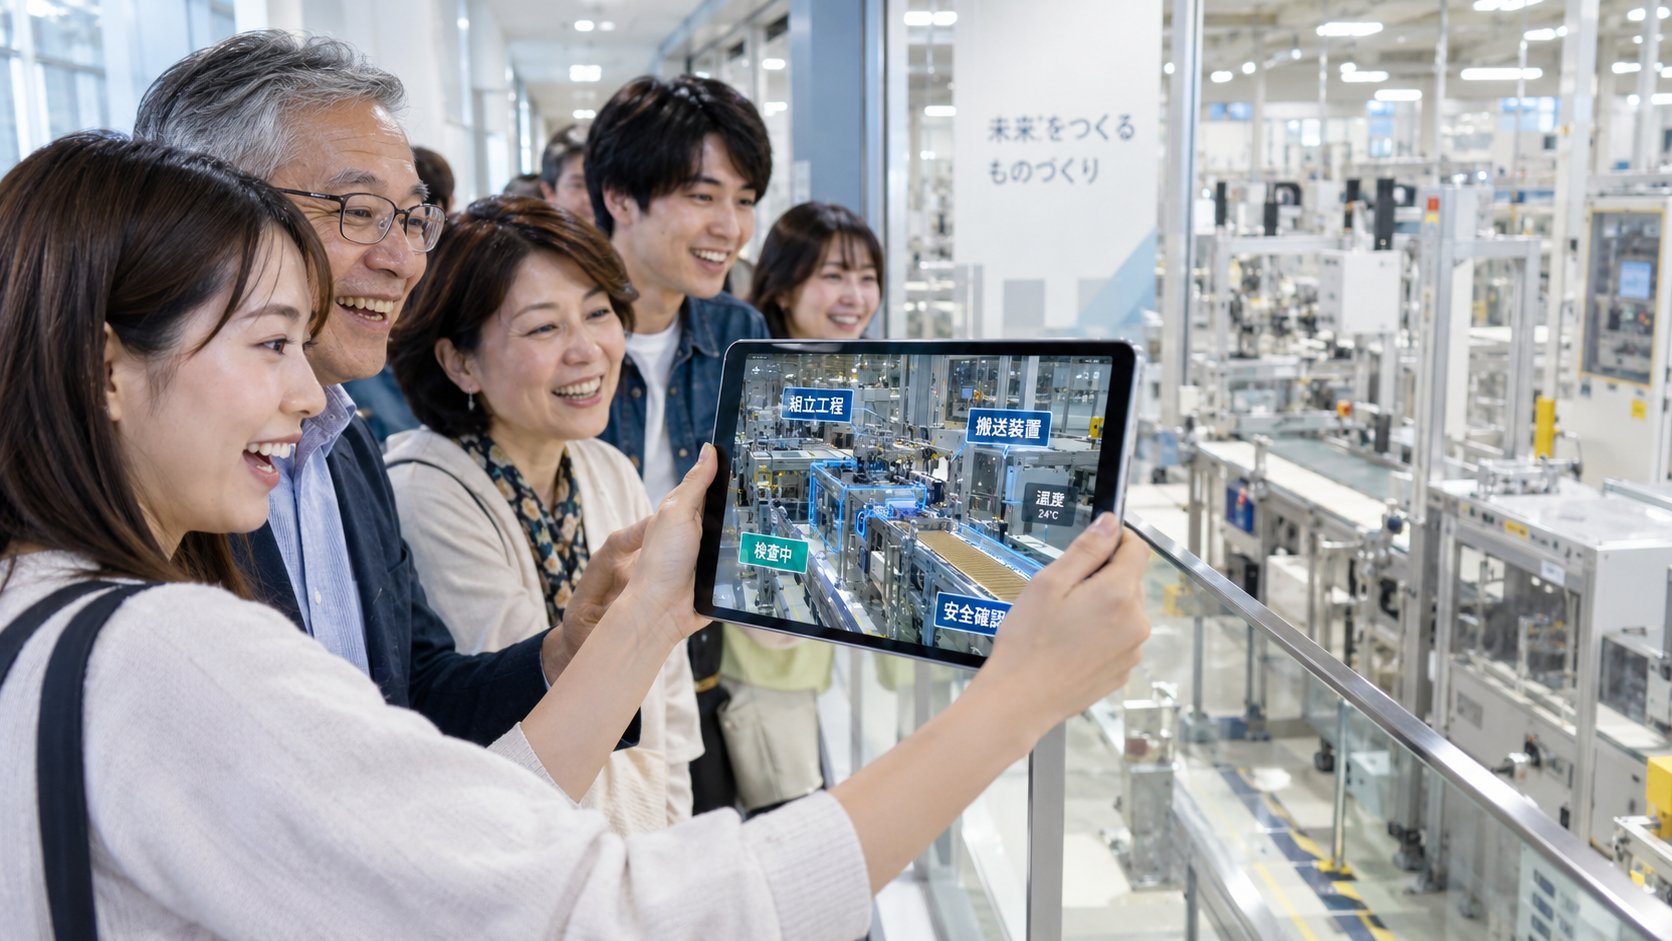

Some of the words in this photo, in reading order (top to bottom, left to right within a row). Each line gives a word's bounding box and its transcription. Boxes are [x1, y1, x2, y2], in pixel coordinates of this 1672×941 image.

[989, 157, 1099, 185] ものづくり
[975, 416, 1041, 439] 搬送装置
[1036, 490, 1065, 507] 温度
[754, 541, 792, 564] 検査中
